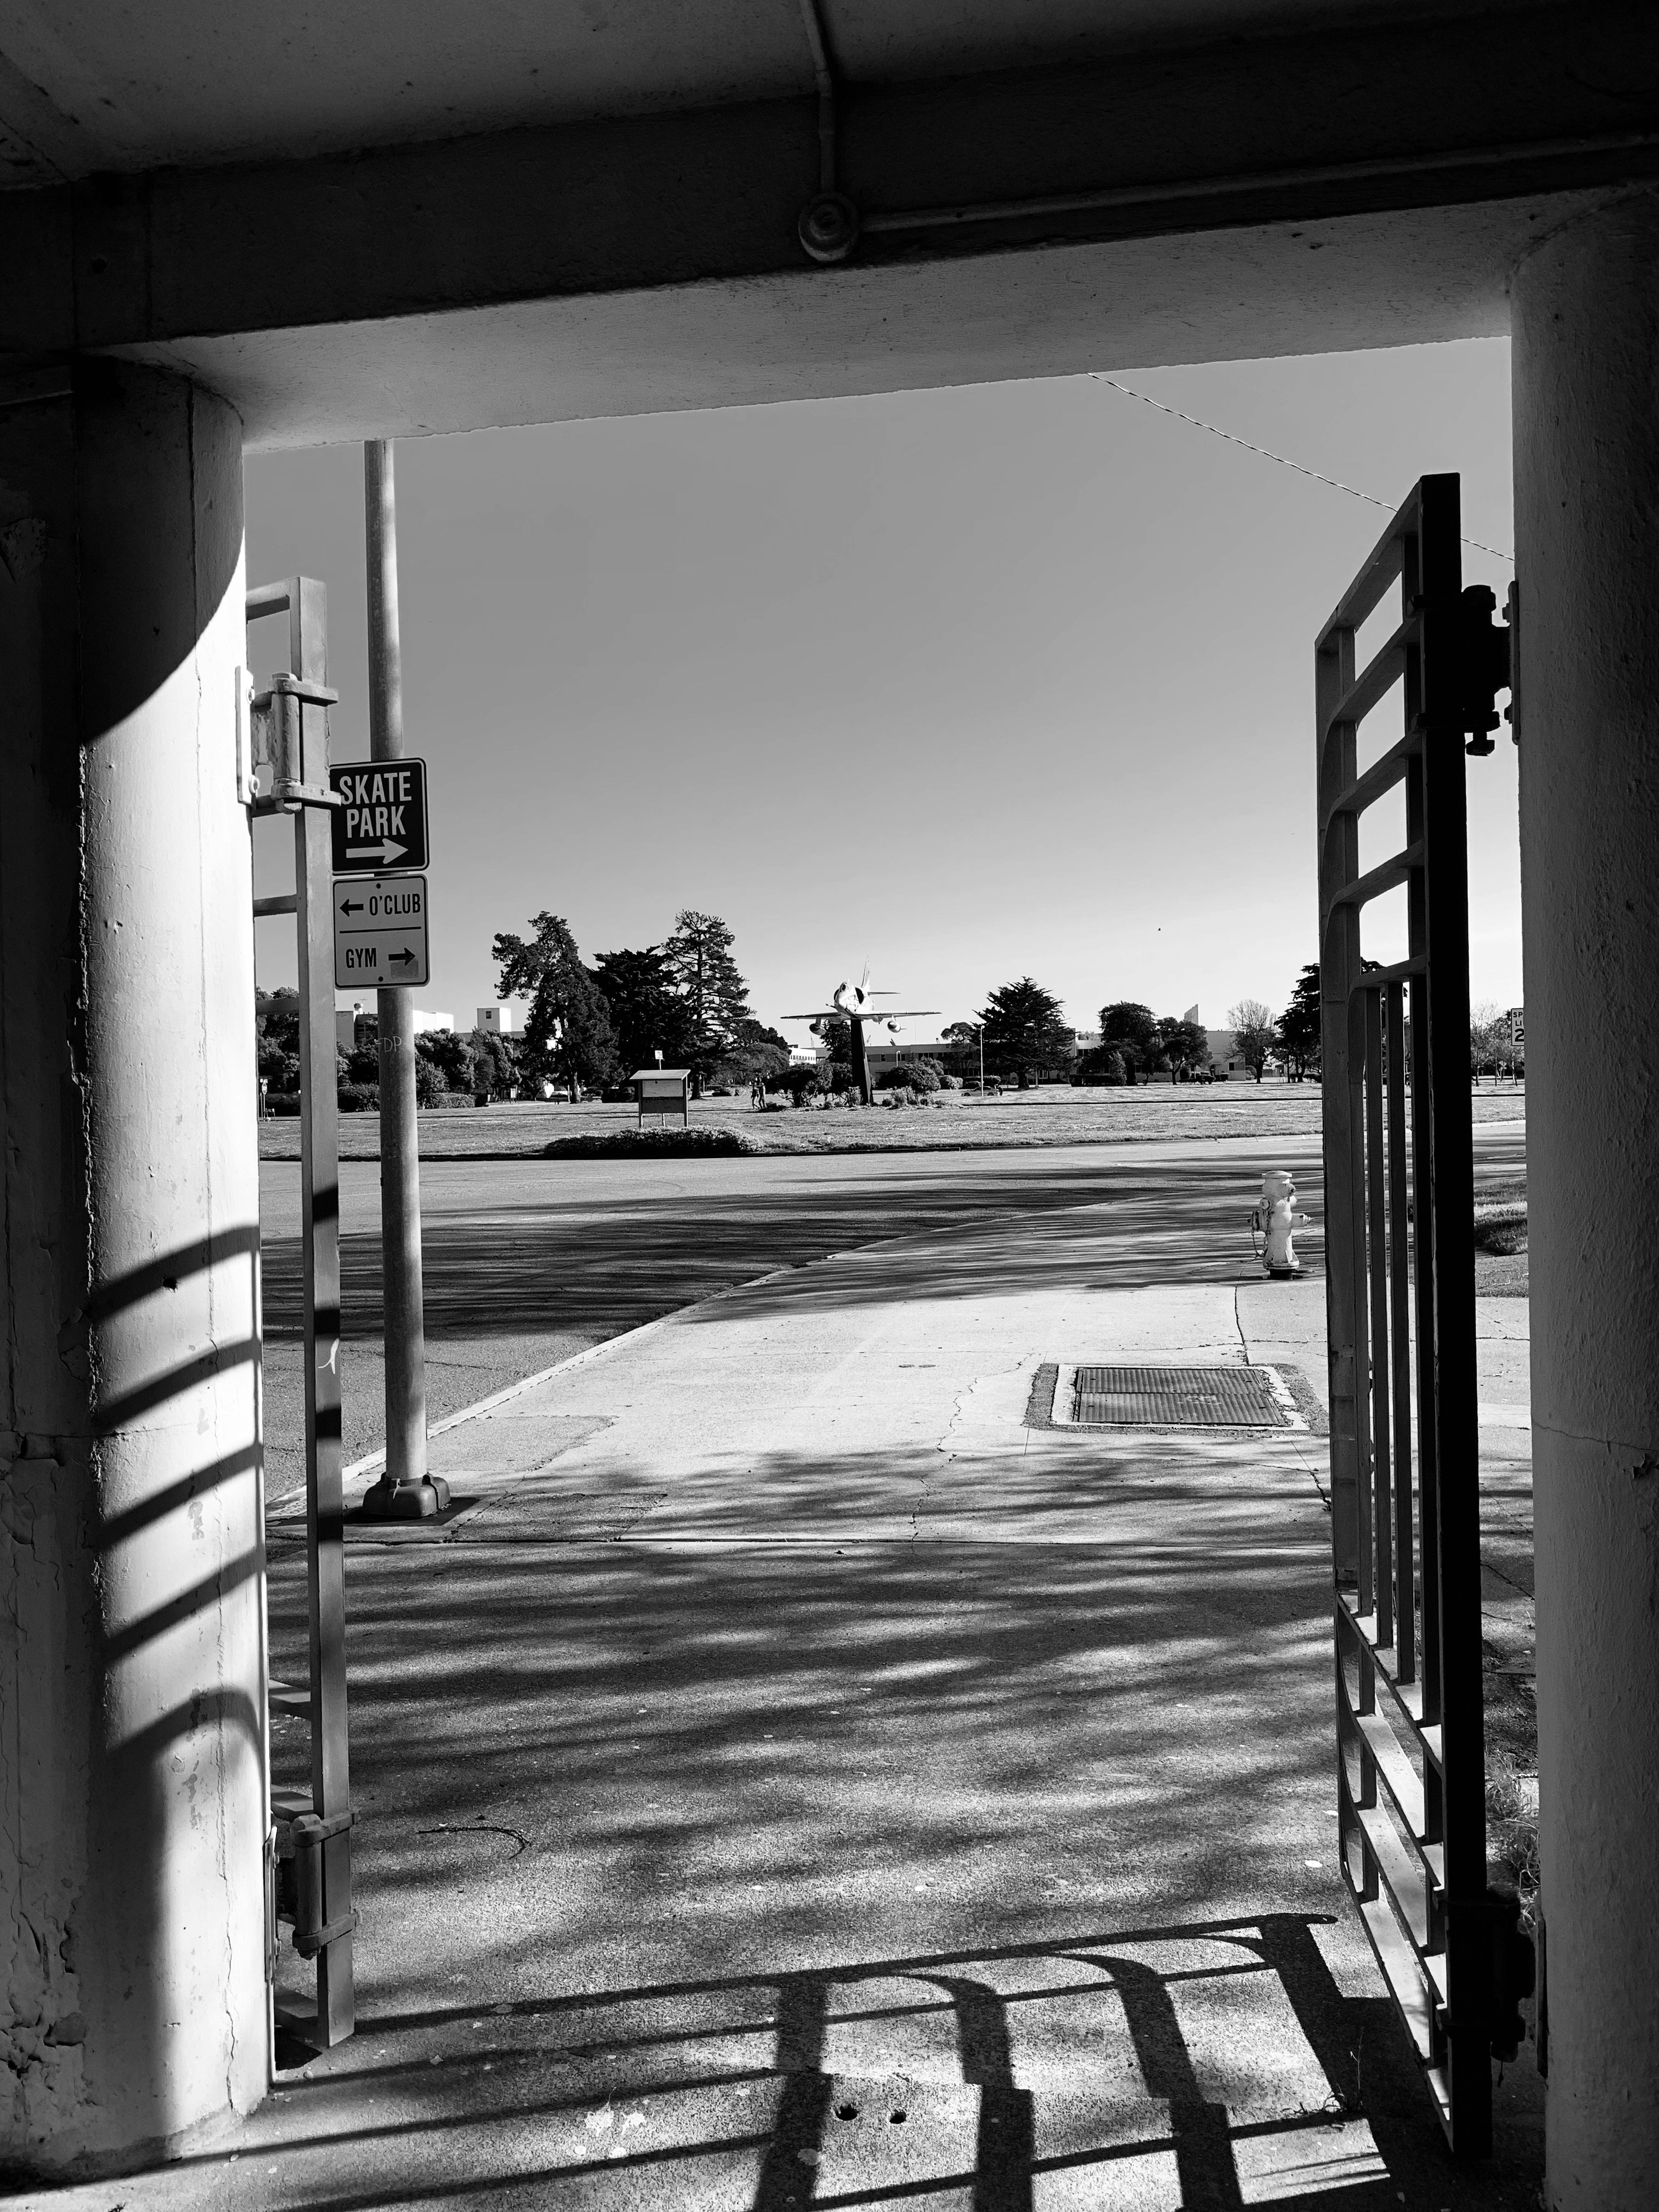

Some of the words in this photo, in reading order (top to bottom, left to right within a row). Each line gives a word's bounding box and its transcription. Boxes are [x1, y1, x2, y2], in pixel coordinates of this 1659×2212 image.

[339, 771, 412, 805] SKATE
[346, 805, 407, 838] PARK
[369, 894, 421, 916] O'CLUB
[345, 948, 377, 968] GYM
